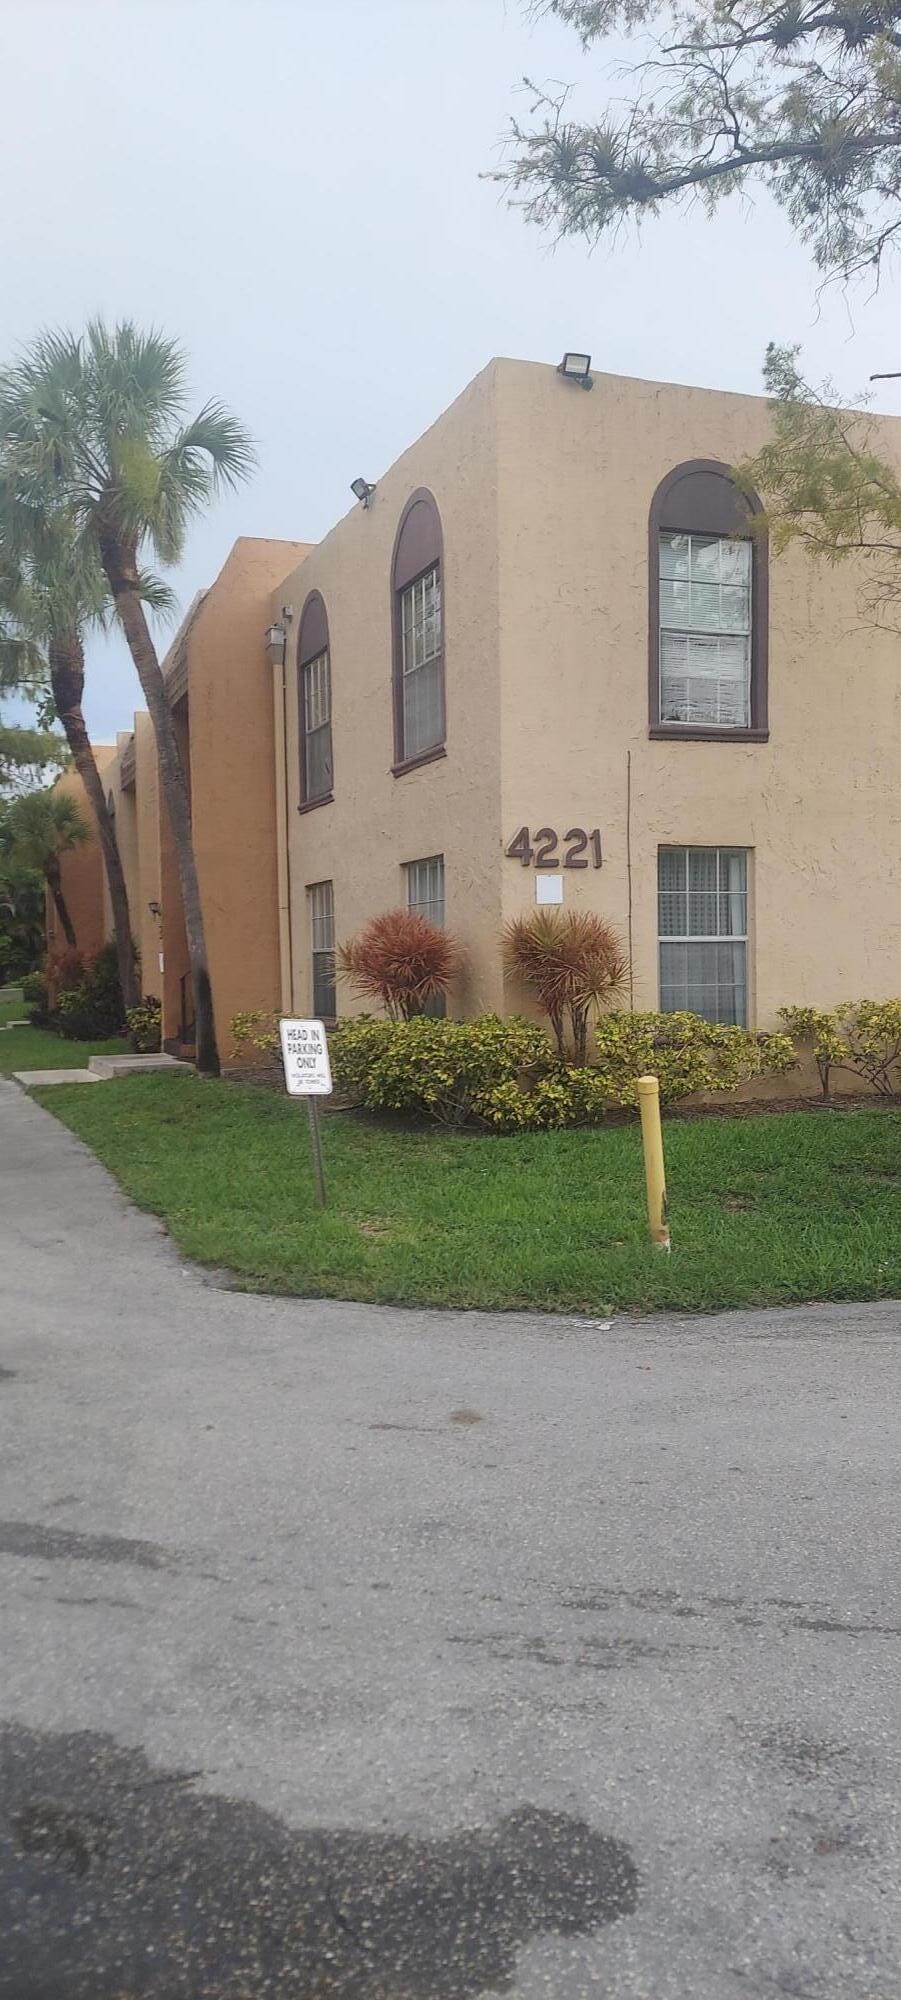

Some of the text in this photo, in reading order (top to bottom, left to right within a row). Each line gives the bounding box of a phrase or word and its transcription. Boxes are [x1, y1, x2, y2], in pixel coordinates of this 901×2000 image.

[505, 826, 602, 869] 4221
[287, 1029, 320, 1041] HEAD IN
[287, 1043, 323, 1055] PARKING
[296, 1057, 316, 1068] ONLY
